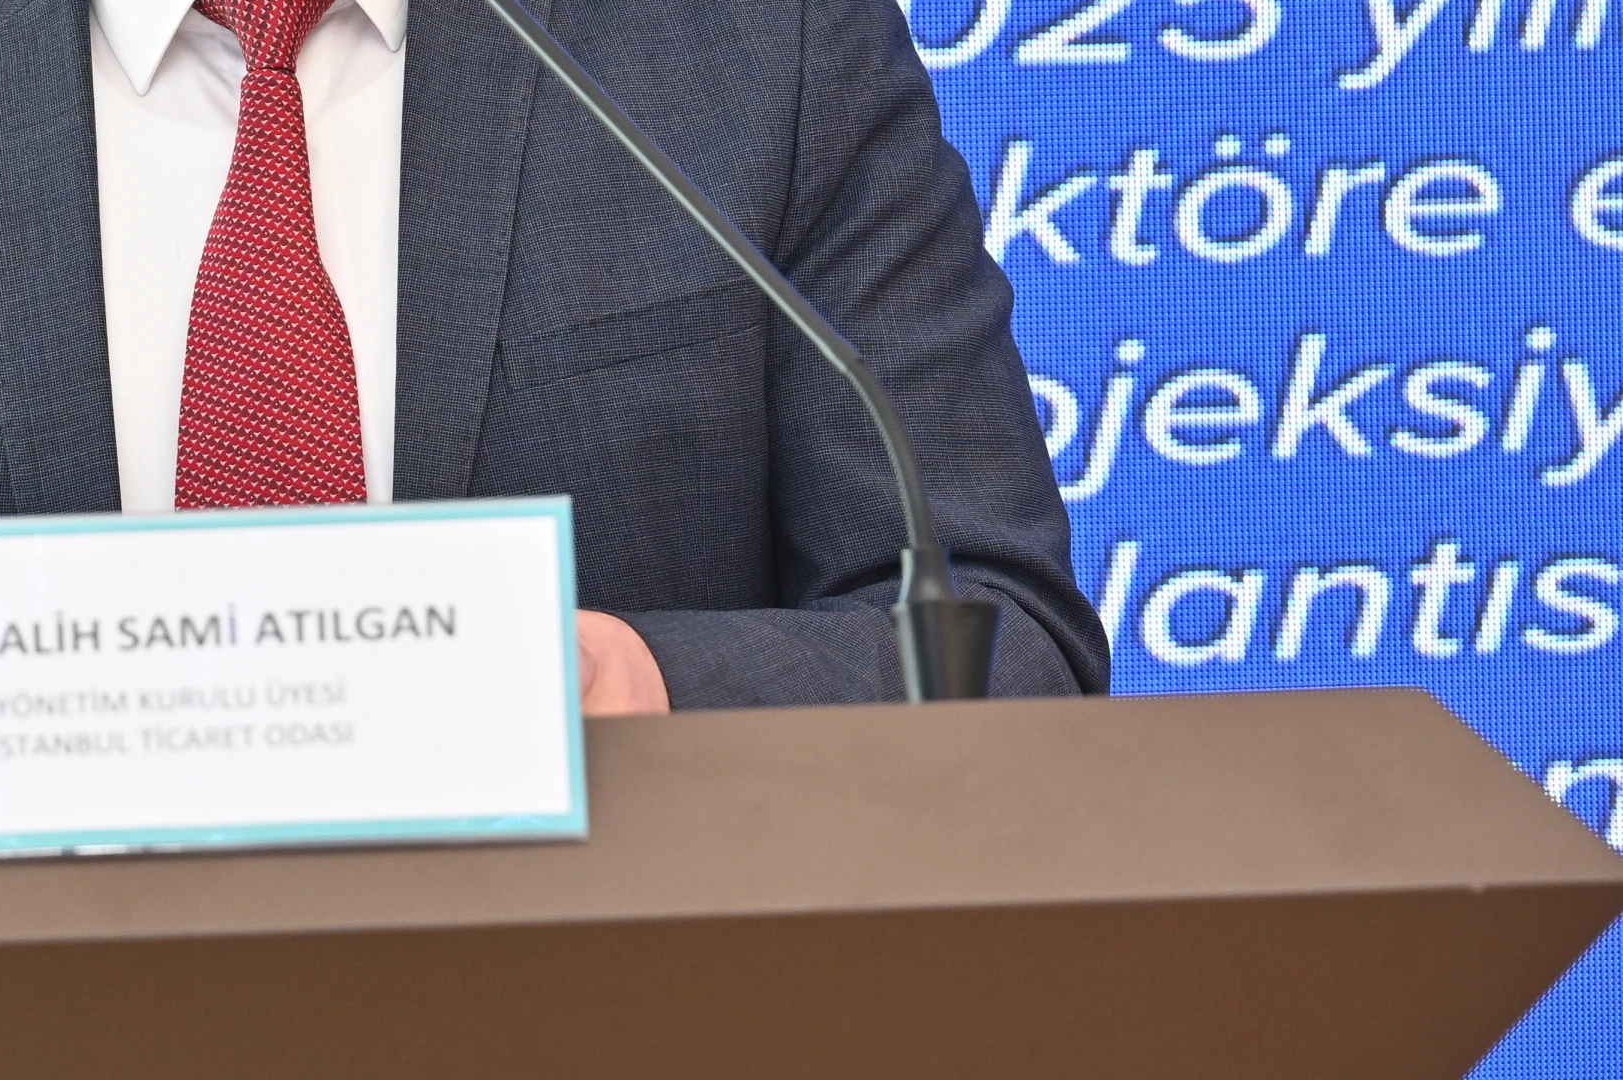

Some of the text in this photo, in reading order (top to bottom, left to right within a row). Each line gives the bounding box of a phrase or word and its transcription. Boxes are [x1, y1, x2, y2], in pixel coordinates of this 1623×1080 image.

[982, 133, 1505, 267] ktöre
[117, 603, 238, 652] SAMİ
[254, 603, 457, 645] ATILGAN
[138, 685, 256, 712] KURULU
[265, 676, 346, 708] ÜYESİ
[141, 721, 255, 753] TİCARET
